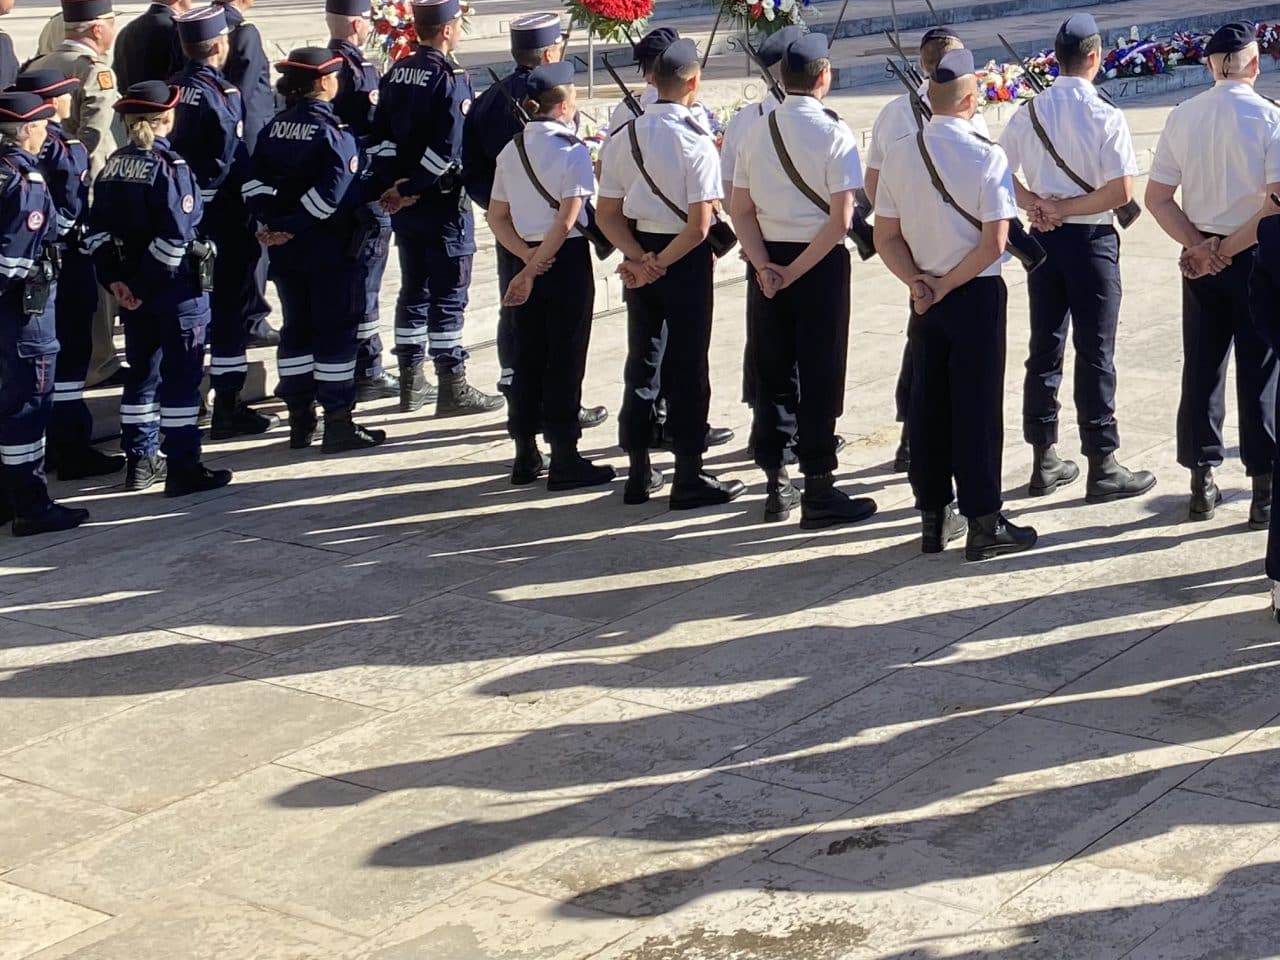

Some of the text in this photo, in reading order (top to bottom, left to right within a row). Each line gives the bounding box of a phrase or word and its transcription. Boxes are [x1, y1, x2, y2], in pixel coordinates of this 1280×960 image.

[389, 67, 433, 87] DOUANE
[178, 85, 203, 106] ANE
[269, 120, 319, 141] DOUANE
[102, 157, 154, 179] DOUANE
